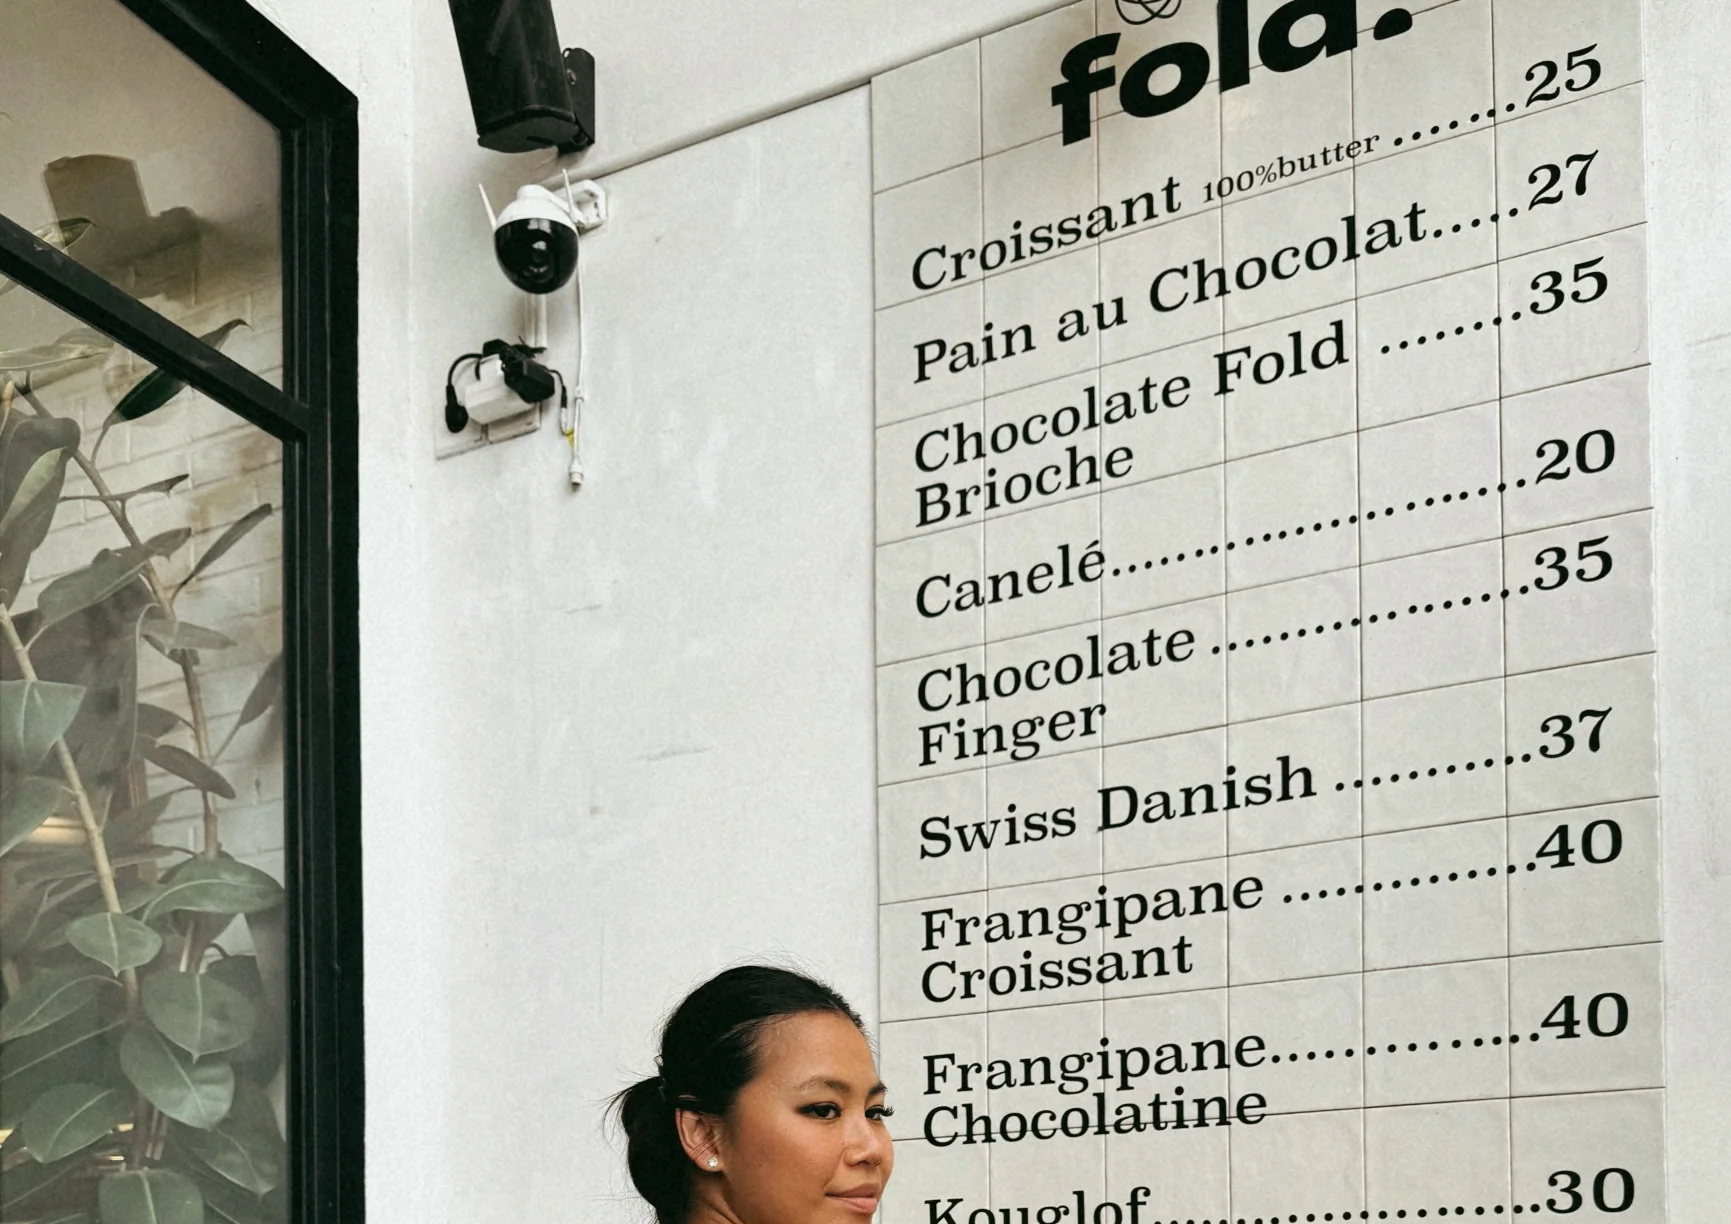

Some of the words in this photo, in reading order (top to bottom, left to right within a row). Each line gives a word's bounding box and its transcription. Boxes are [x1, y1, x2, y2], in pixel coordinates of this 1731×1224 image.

[913, 177, 1182, 291] Croissant
[1526, 44, 1602, 107] 25
[914, 324, 1037, 383] Pain
[1057, 297, 1128, 341] au
[1149, 203, 1428, 313] Chocolat
[1529, 150, 1599, 211] 27
[914, 376, 1192, 473] Chocolate
[1214, 320, 1350, 397] Fold
[1530, 256, 1609, 315] 35
[915, 446, 1135, 529] Brioche
[916, 540, 1107, 618] Canelé
[1536, 428, 1615, 485] 20
[917, 629, 1196, 712] Chocolate
[1534, 536, 1613, 591] 35
[918, 703, 1108, 767] Finger
[920, 803, 1078, 861] Swiss
[1097, 755, 1317, 832] Danish
[1539, 707, 1613, 759] 37
[921, 876, 1265, 952] Frangipane
[1535, 820, 1623, 869] 40
[921, 935, 1194, 1004] Croissant
[922, 1035, 1266, 1097] Frangipane
[1540, 993, 1630, 1041] 40
[922, 1090, 1268, 1148] Chocolatine
[1546, 1168, 1636, 1214] 30
